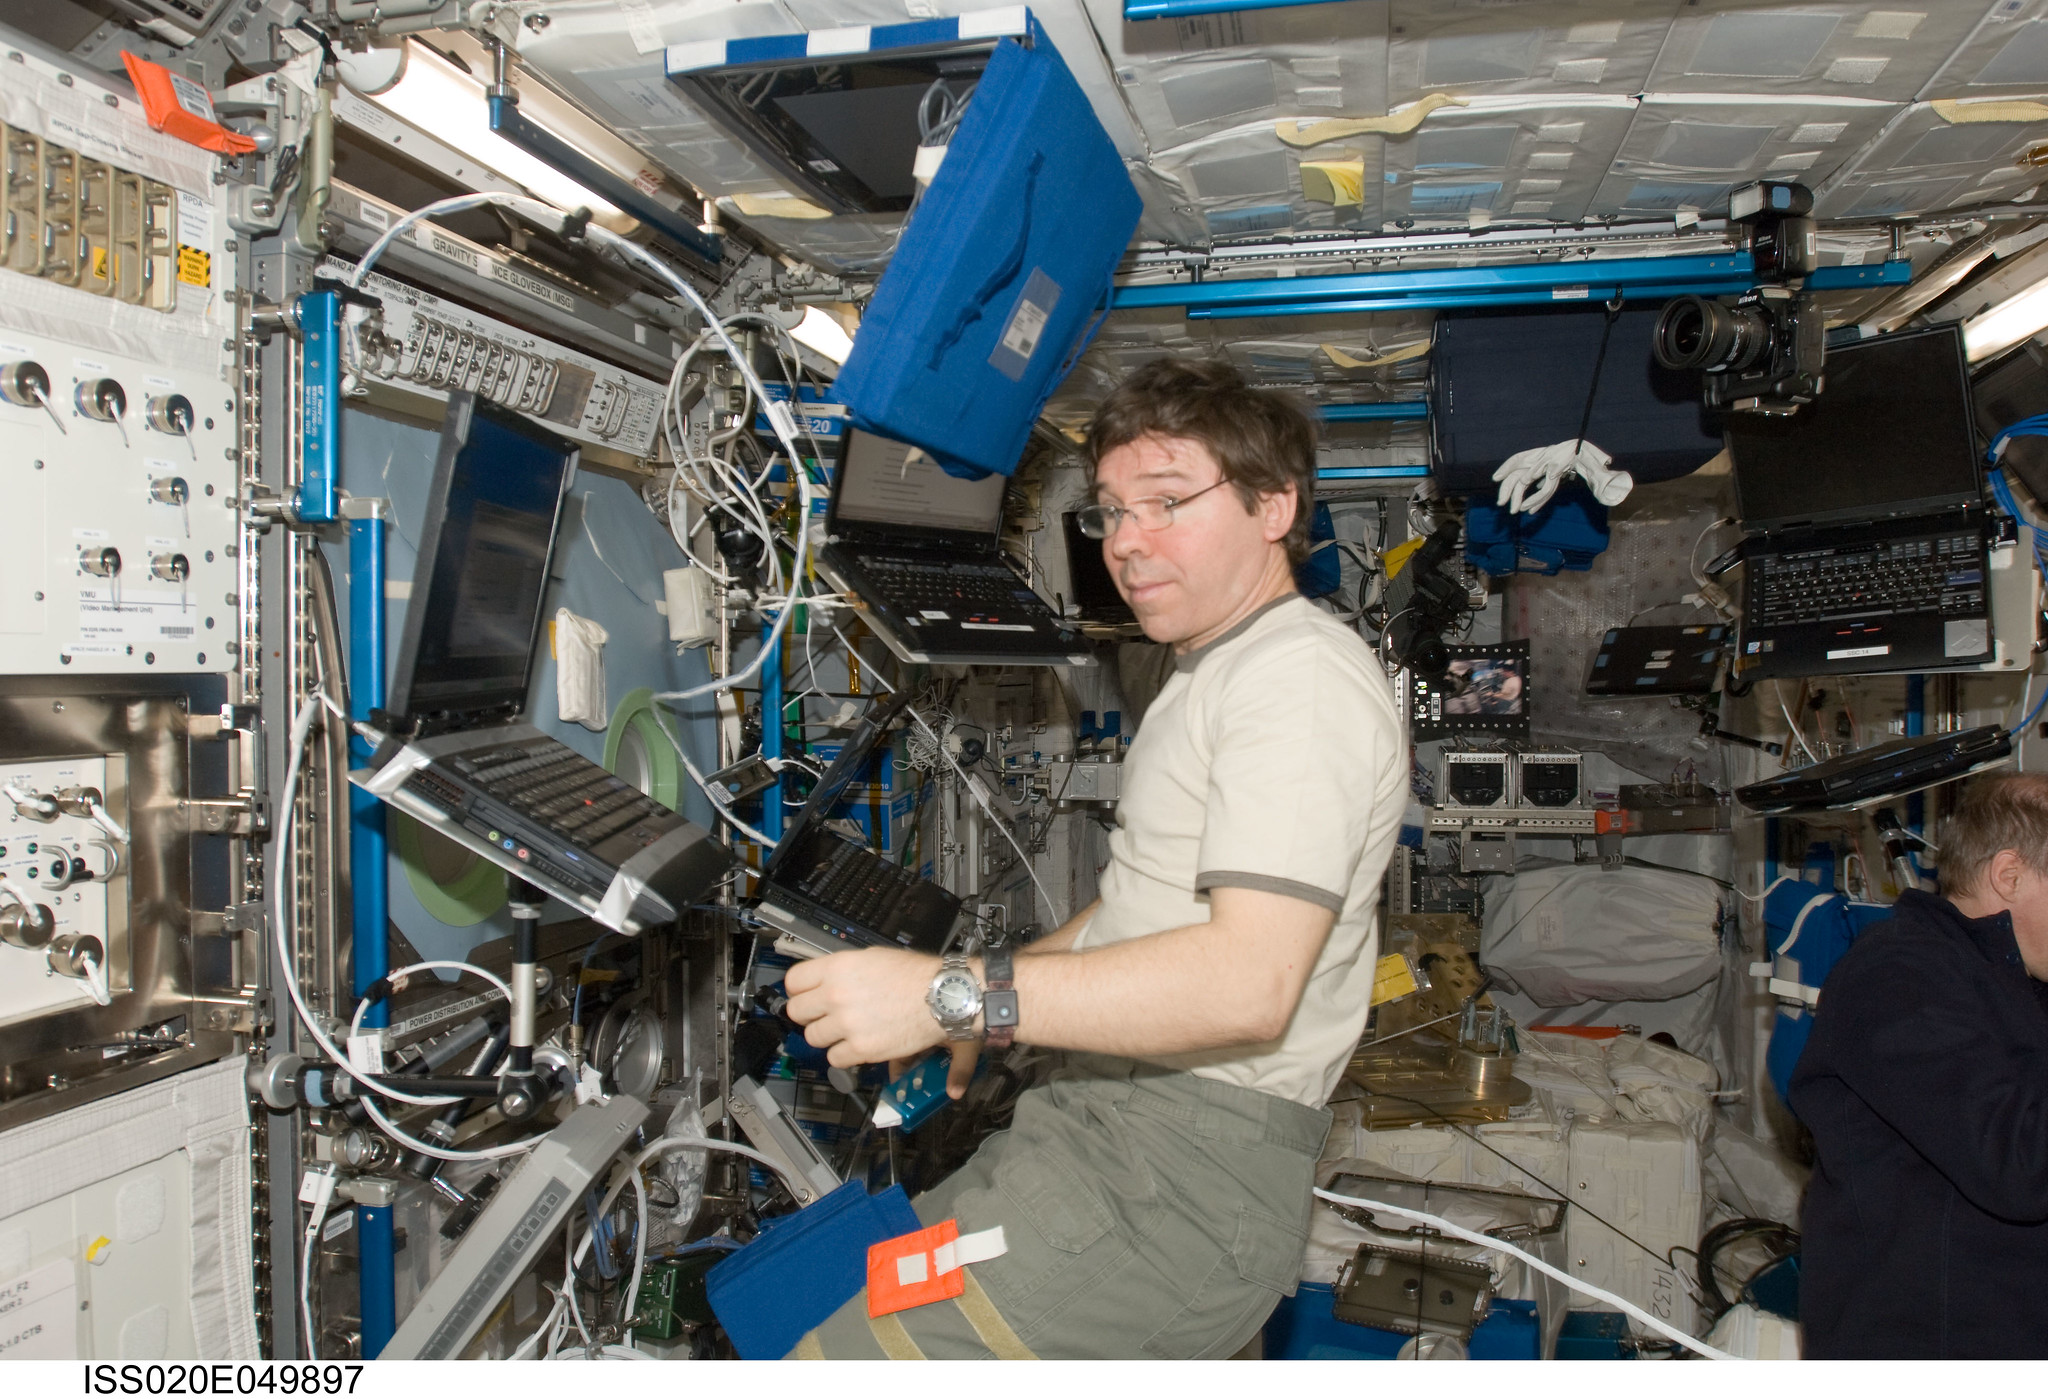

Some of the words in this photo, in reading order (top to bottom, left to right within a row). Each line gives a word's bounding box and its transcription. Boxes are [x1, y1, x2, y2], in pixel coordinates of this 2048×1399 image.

[183, 193, 204, 209] RPDA
[433, 238, 472, 264] GRAVITY
[510, 275, 552, 302] GLOVEBOX
[552, 292, 574, 310] (MSG)
[366, 271, 402, 292] ONITORING
[402, 285, 421, 299] PANEL
[1738, 294, 1758, 305] Nikon
[80, 590, 96, 599] VMU
[80, 604, 100, 613] (Video
[139, 605, 153, 614] Unit)
[409, 1012, 433, 1029] POWER
[433, 999, 475, 1020] DISTRIBUTION
[1652, 1267, 1674, 1320] 1432
[21, 1324, 42, 1340] CTB
